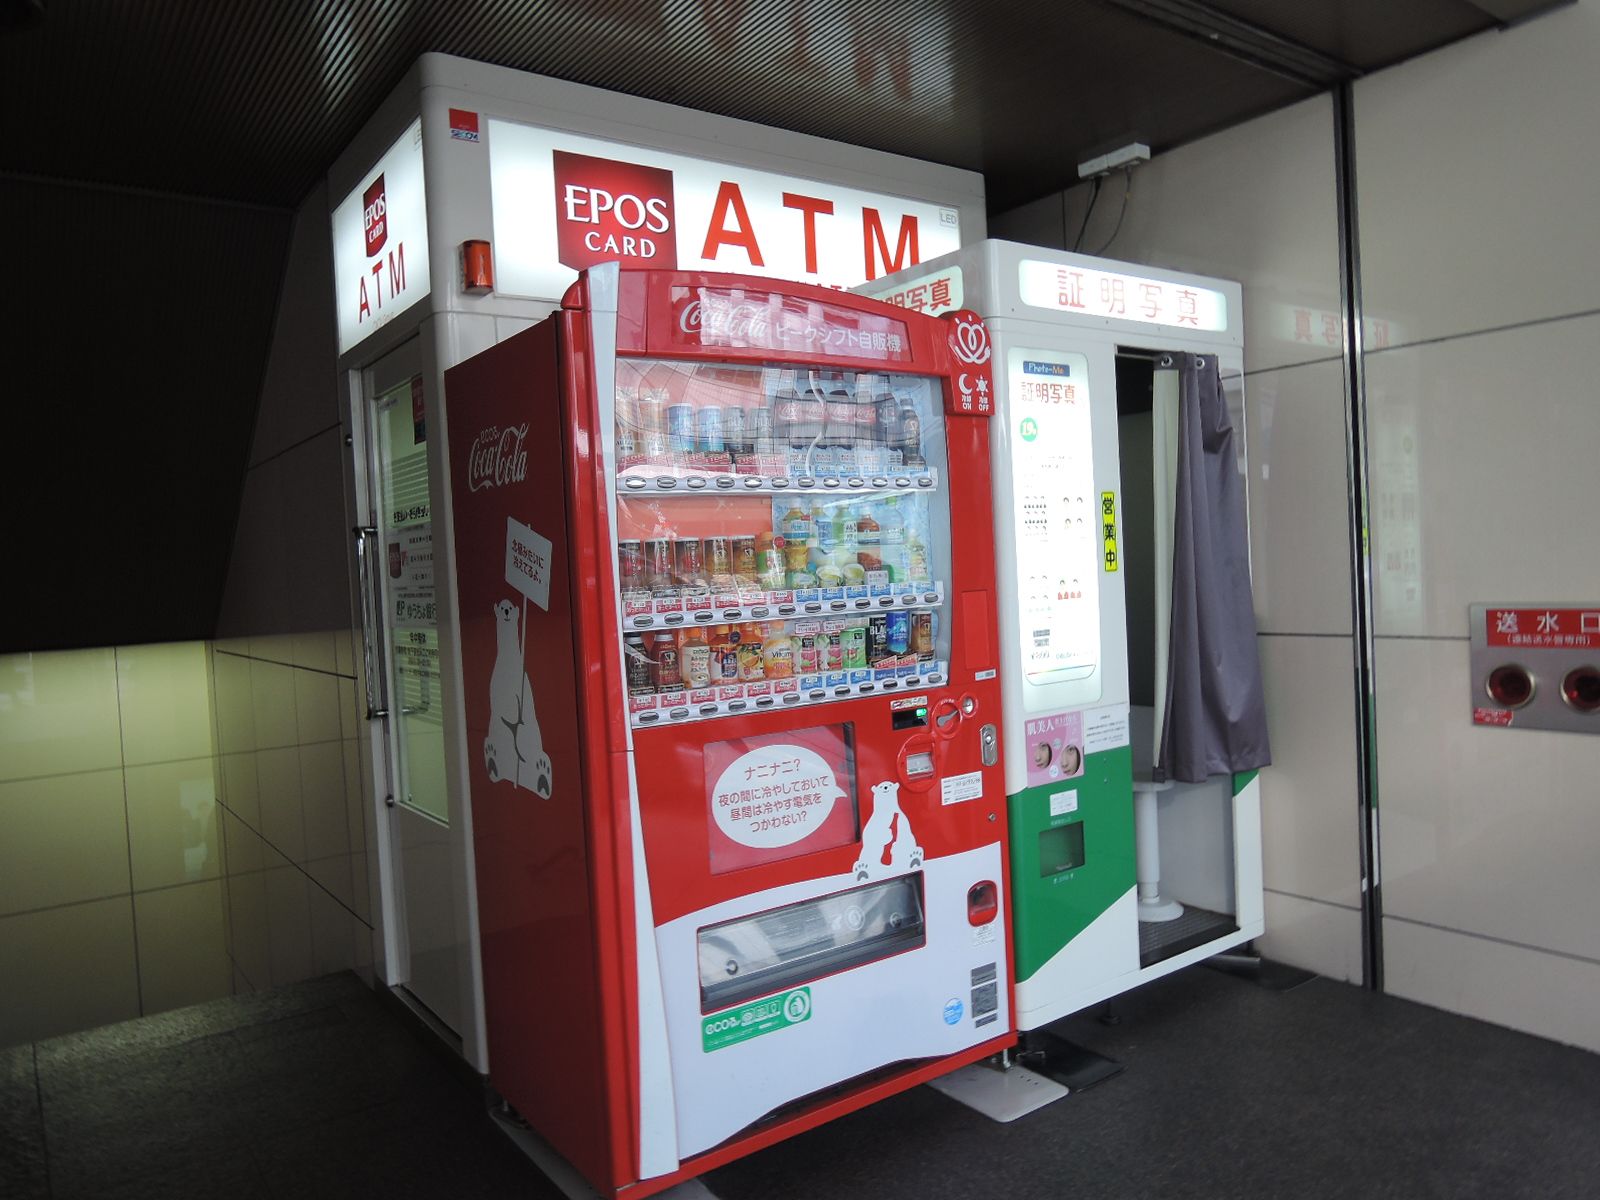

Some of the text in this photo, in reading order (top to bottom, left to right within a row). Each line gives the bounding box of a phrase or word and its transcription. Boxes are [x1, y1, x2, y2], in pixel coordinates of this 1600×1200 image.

[365, 193, 386, 230] EPOS
[564, 184, 671, 233] EPOS
[940, 213, 957, 225] LED
[368, 221, 384, 243] CARD
[584, 231, 657, 258] CARD
[701, 180, 920, 281] ATM
[359, 241, 406, 323] ATM
[1057, 269, 1199, 326] 証明写真
[962, 402, 972, 411] ON
[978, 404, 990, 412] OFF
[1021, 382, 1075, 404] 証明写真
[469, 423, 530, 492] Coca-Cola
[1103, 496, 1116, 567] 営業中
[1496, 610, 1600, 633] 送水口
[718, 775, 829, 808] 夜の間に冷やしておいて
[730, 793, 822, 822] 昼間は冷やす電気を
